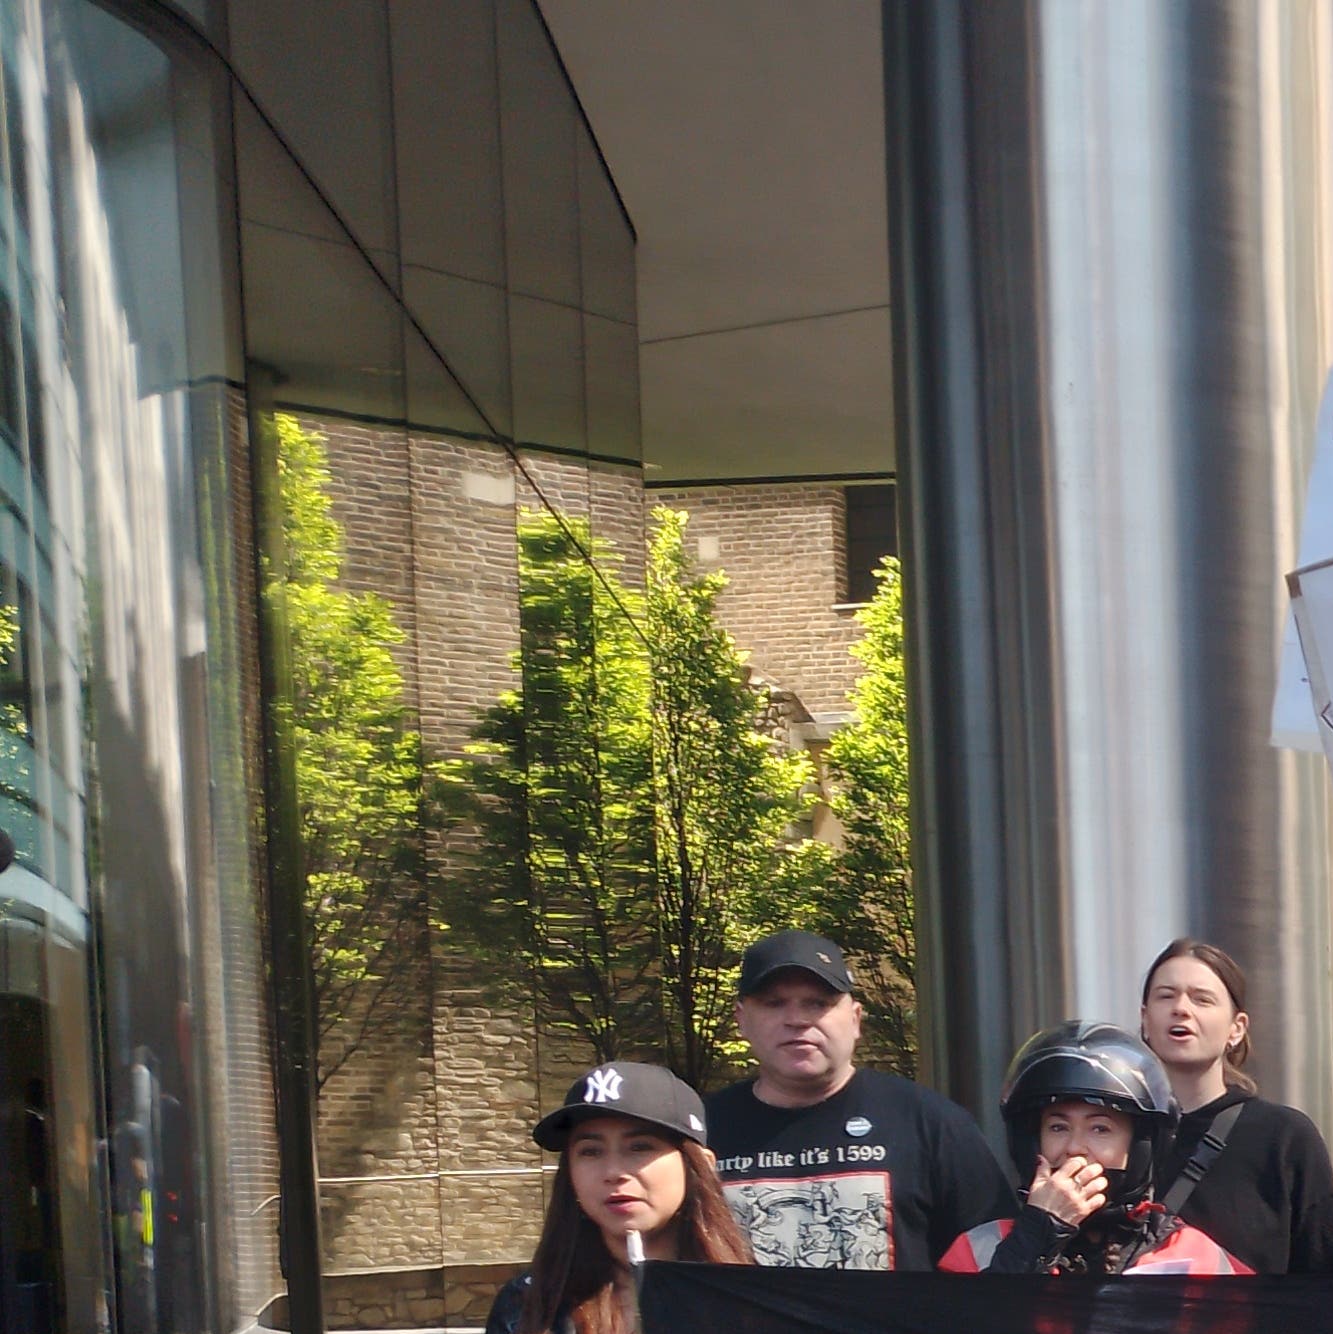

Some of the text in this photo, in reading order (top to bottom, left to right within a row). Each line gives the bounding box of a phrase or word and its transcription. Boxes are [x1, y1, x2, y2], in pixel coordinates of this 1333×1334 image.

[717, 1145, 887, 1174] arty like it's 1599
